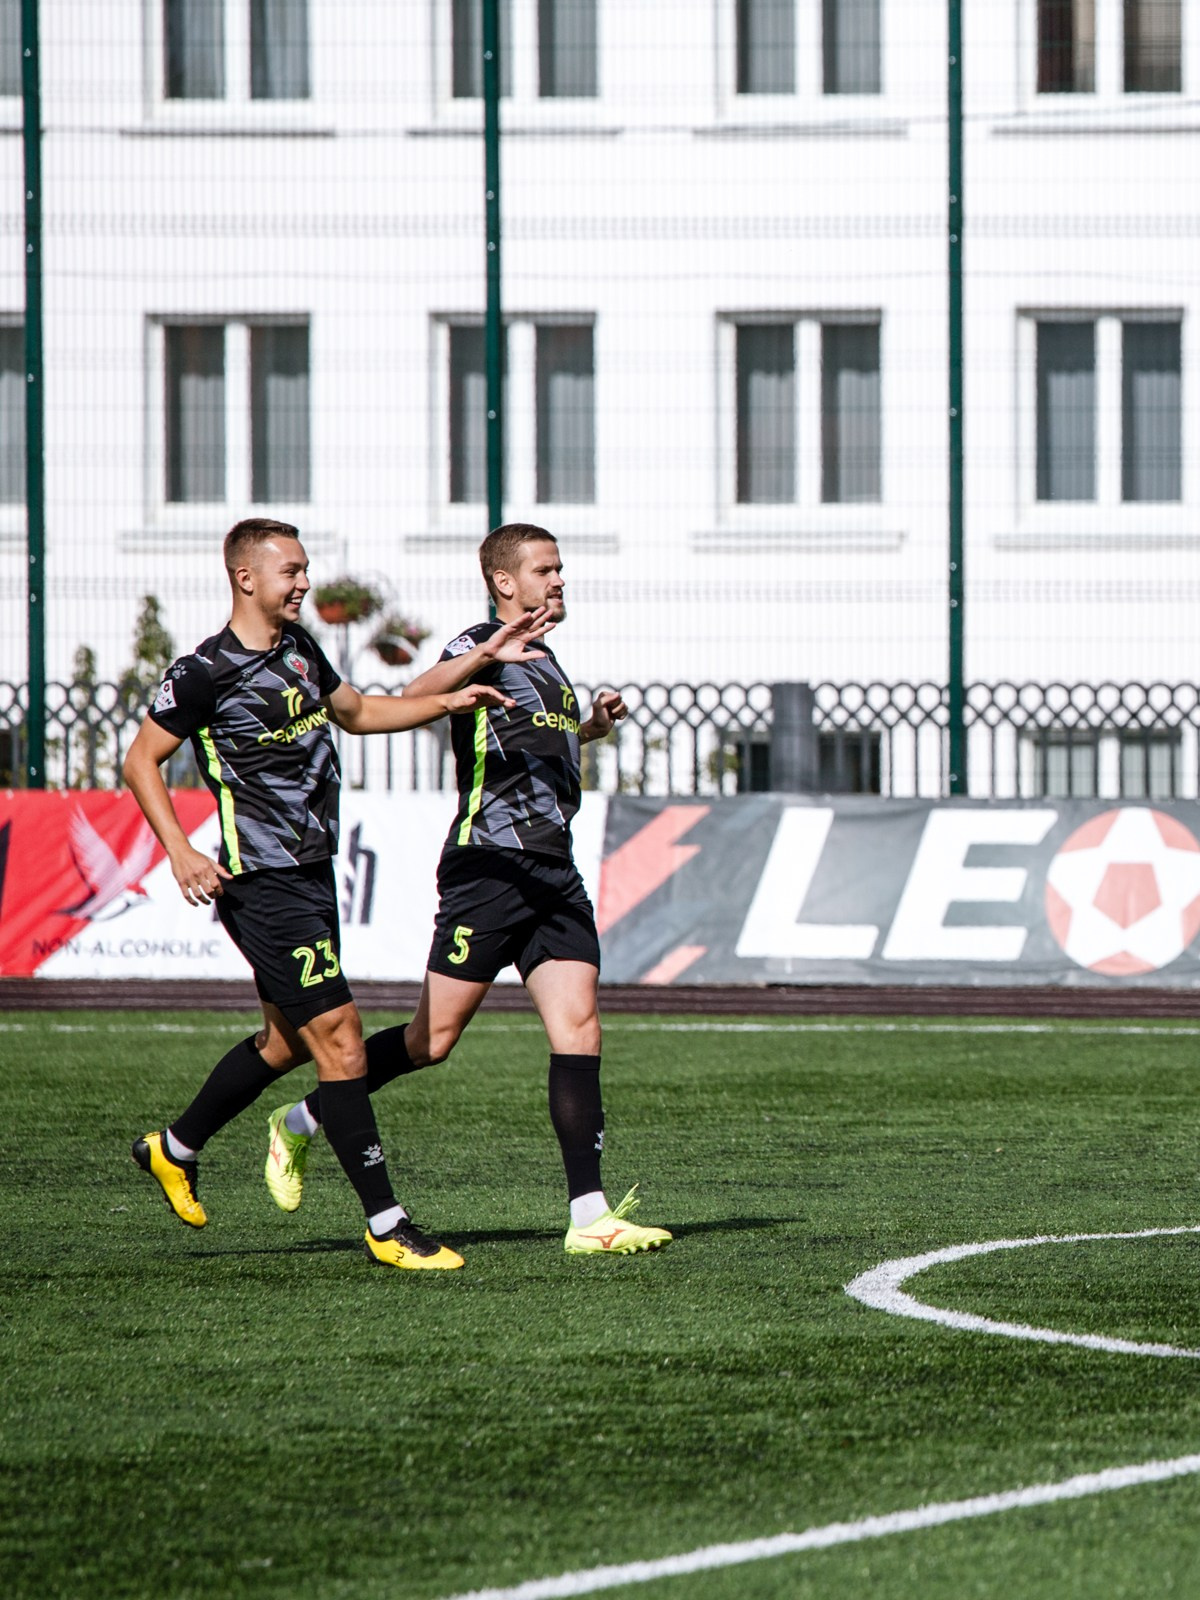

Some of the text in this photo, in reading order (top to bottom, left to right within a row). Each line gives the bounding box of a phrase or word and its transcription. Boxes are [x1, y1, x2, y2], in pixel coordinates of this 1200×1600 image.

[532, 711, 580, 735] серви
[32, 938, 222, 960] NON-ALCOHOLIC
[447, 925, 473, 964] 5
[292, 938, 340, 988] 23
